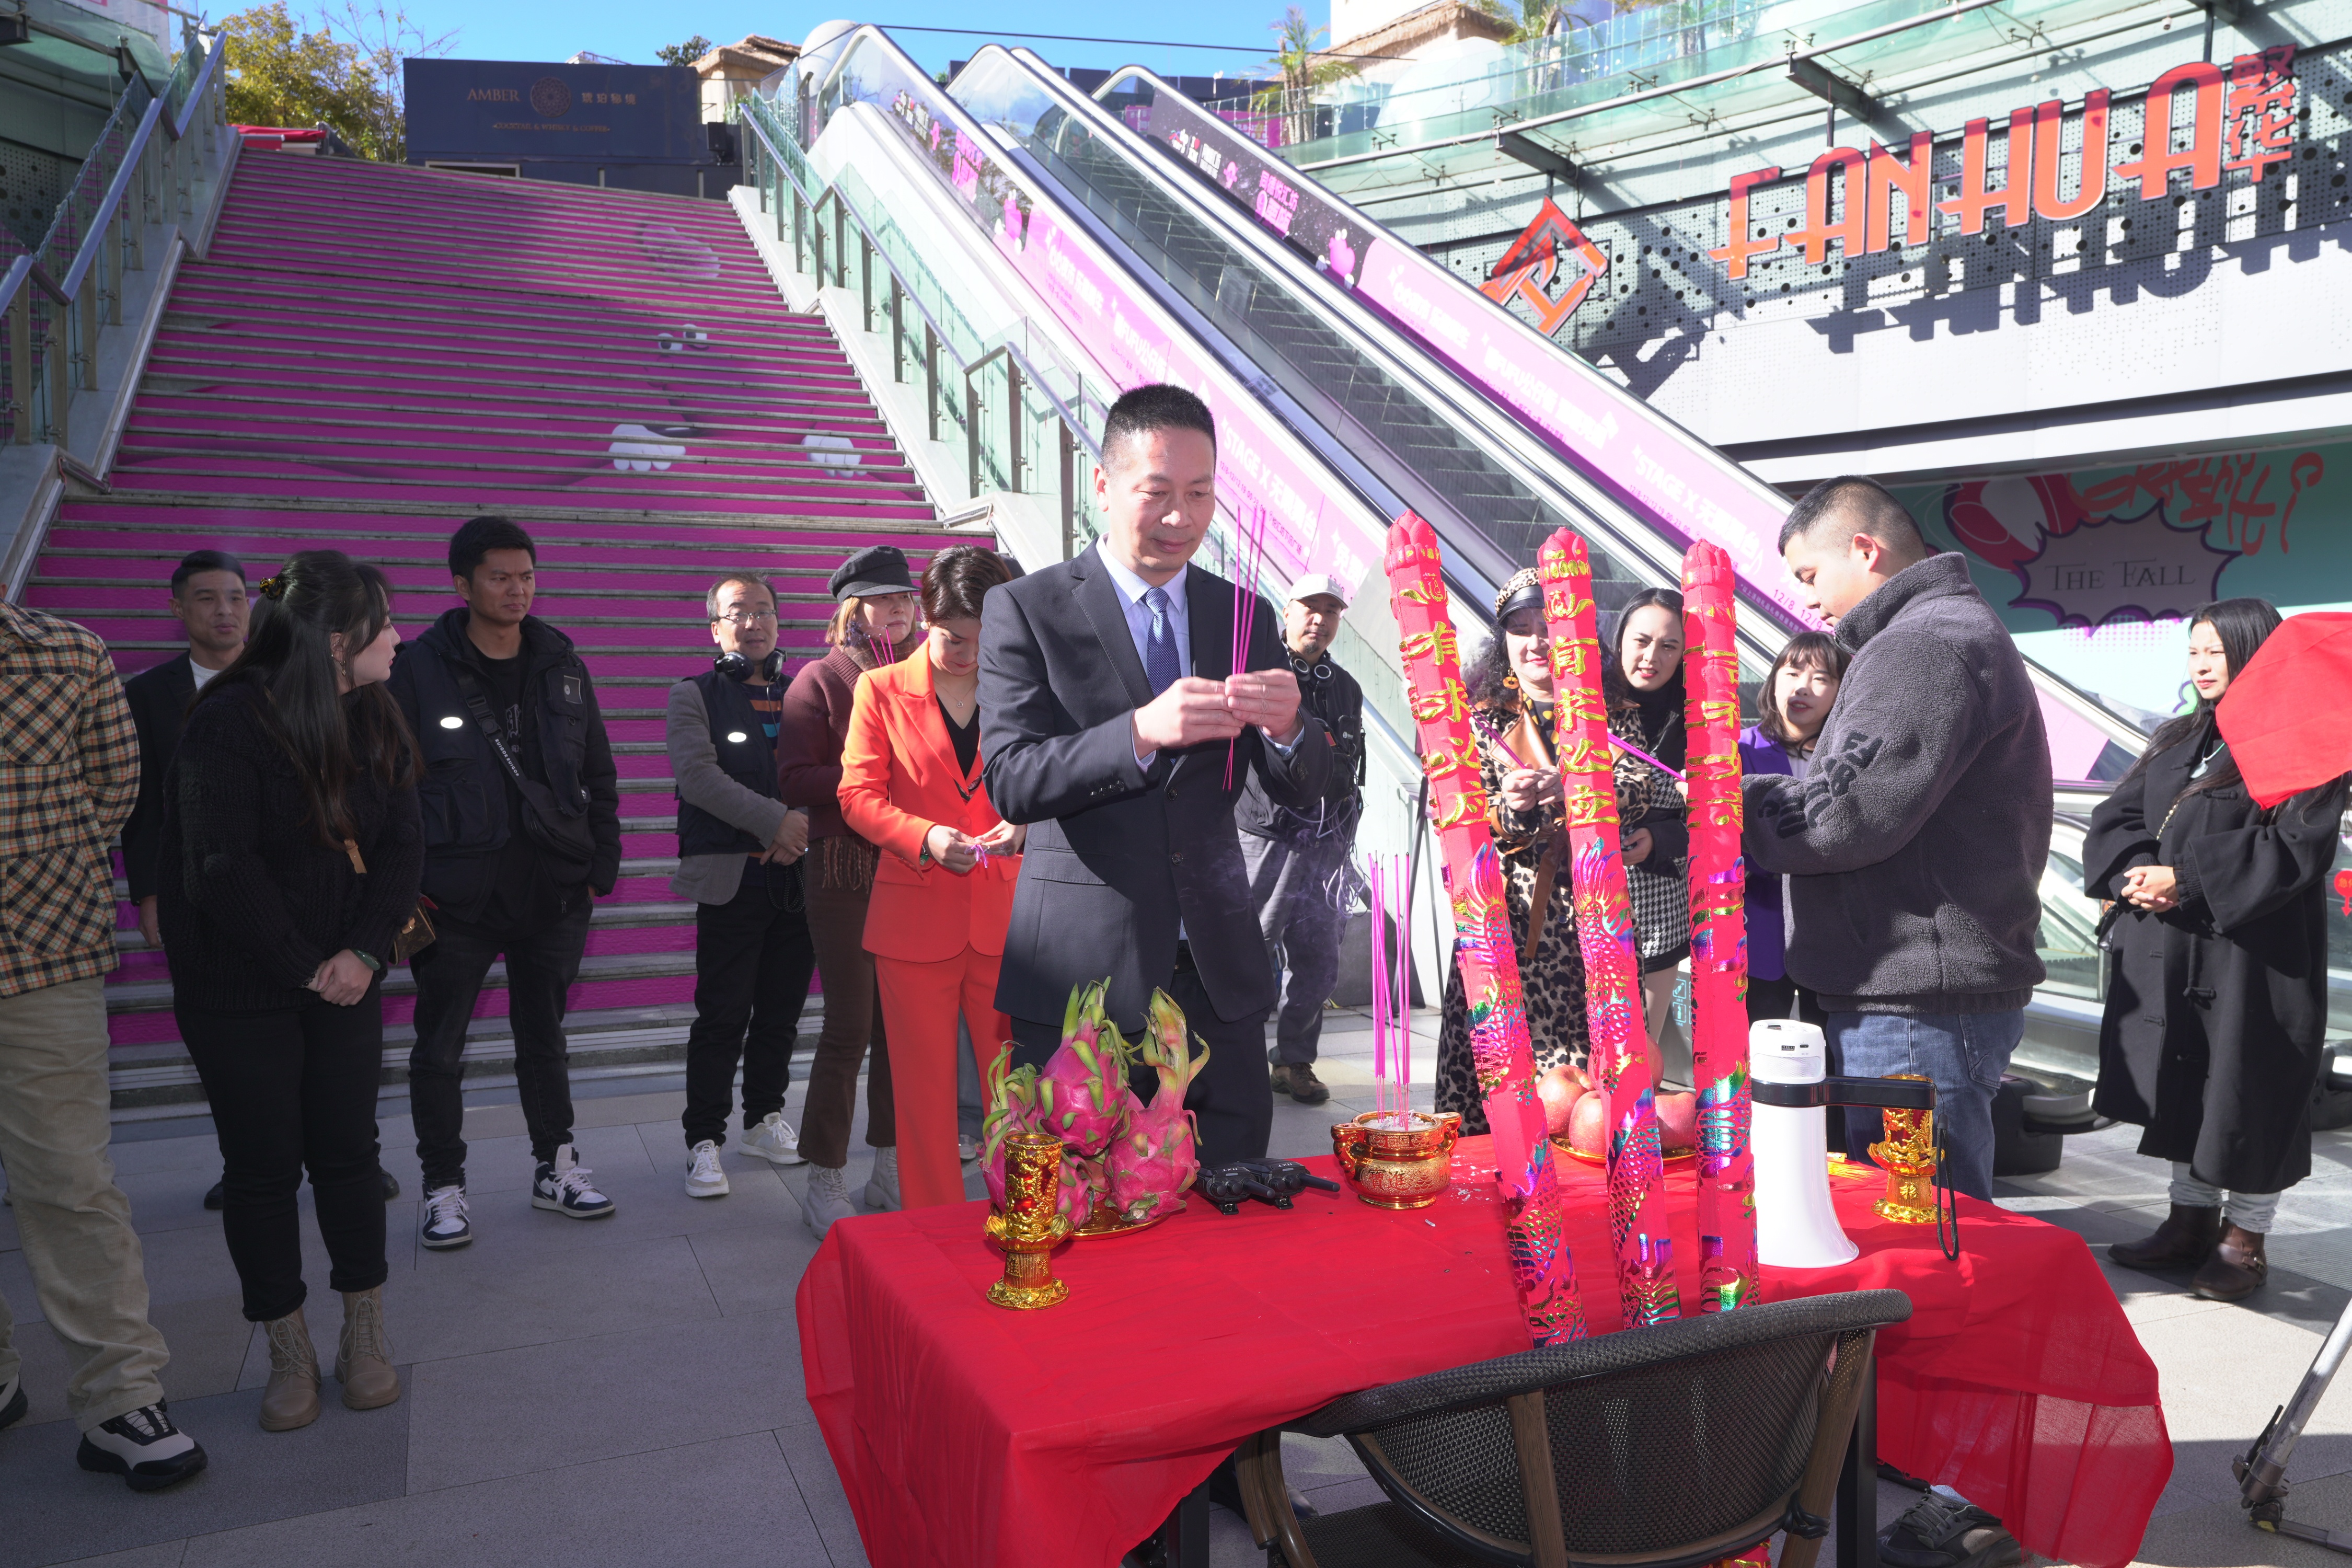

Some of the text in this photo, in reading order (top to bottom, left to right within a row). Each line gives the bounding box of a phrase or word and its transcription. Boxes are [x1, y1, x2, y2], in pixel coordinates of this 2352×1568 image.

[467, 88, 521, 102] AMBER
[1259, 170, 1299, 212] 同德悦汇坊
[1223, 430, 1261, 478] STAGE
[1258, 463, 1272, 490] X
[1635, 454, 1687, 502] STAGE
[1683, 488, 1700, 514] X
[2044, 557, 2196, 591] THE FALL
[1773, 589, 1823, 631] 12/8 12/9
[494, 739, 509, 758] RUIGOR
[506, 757, 520, 777] RUIGOR
